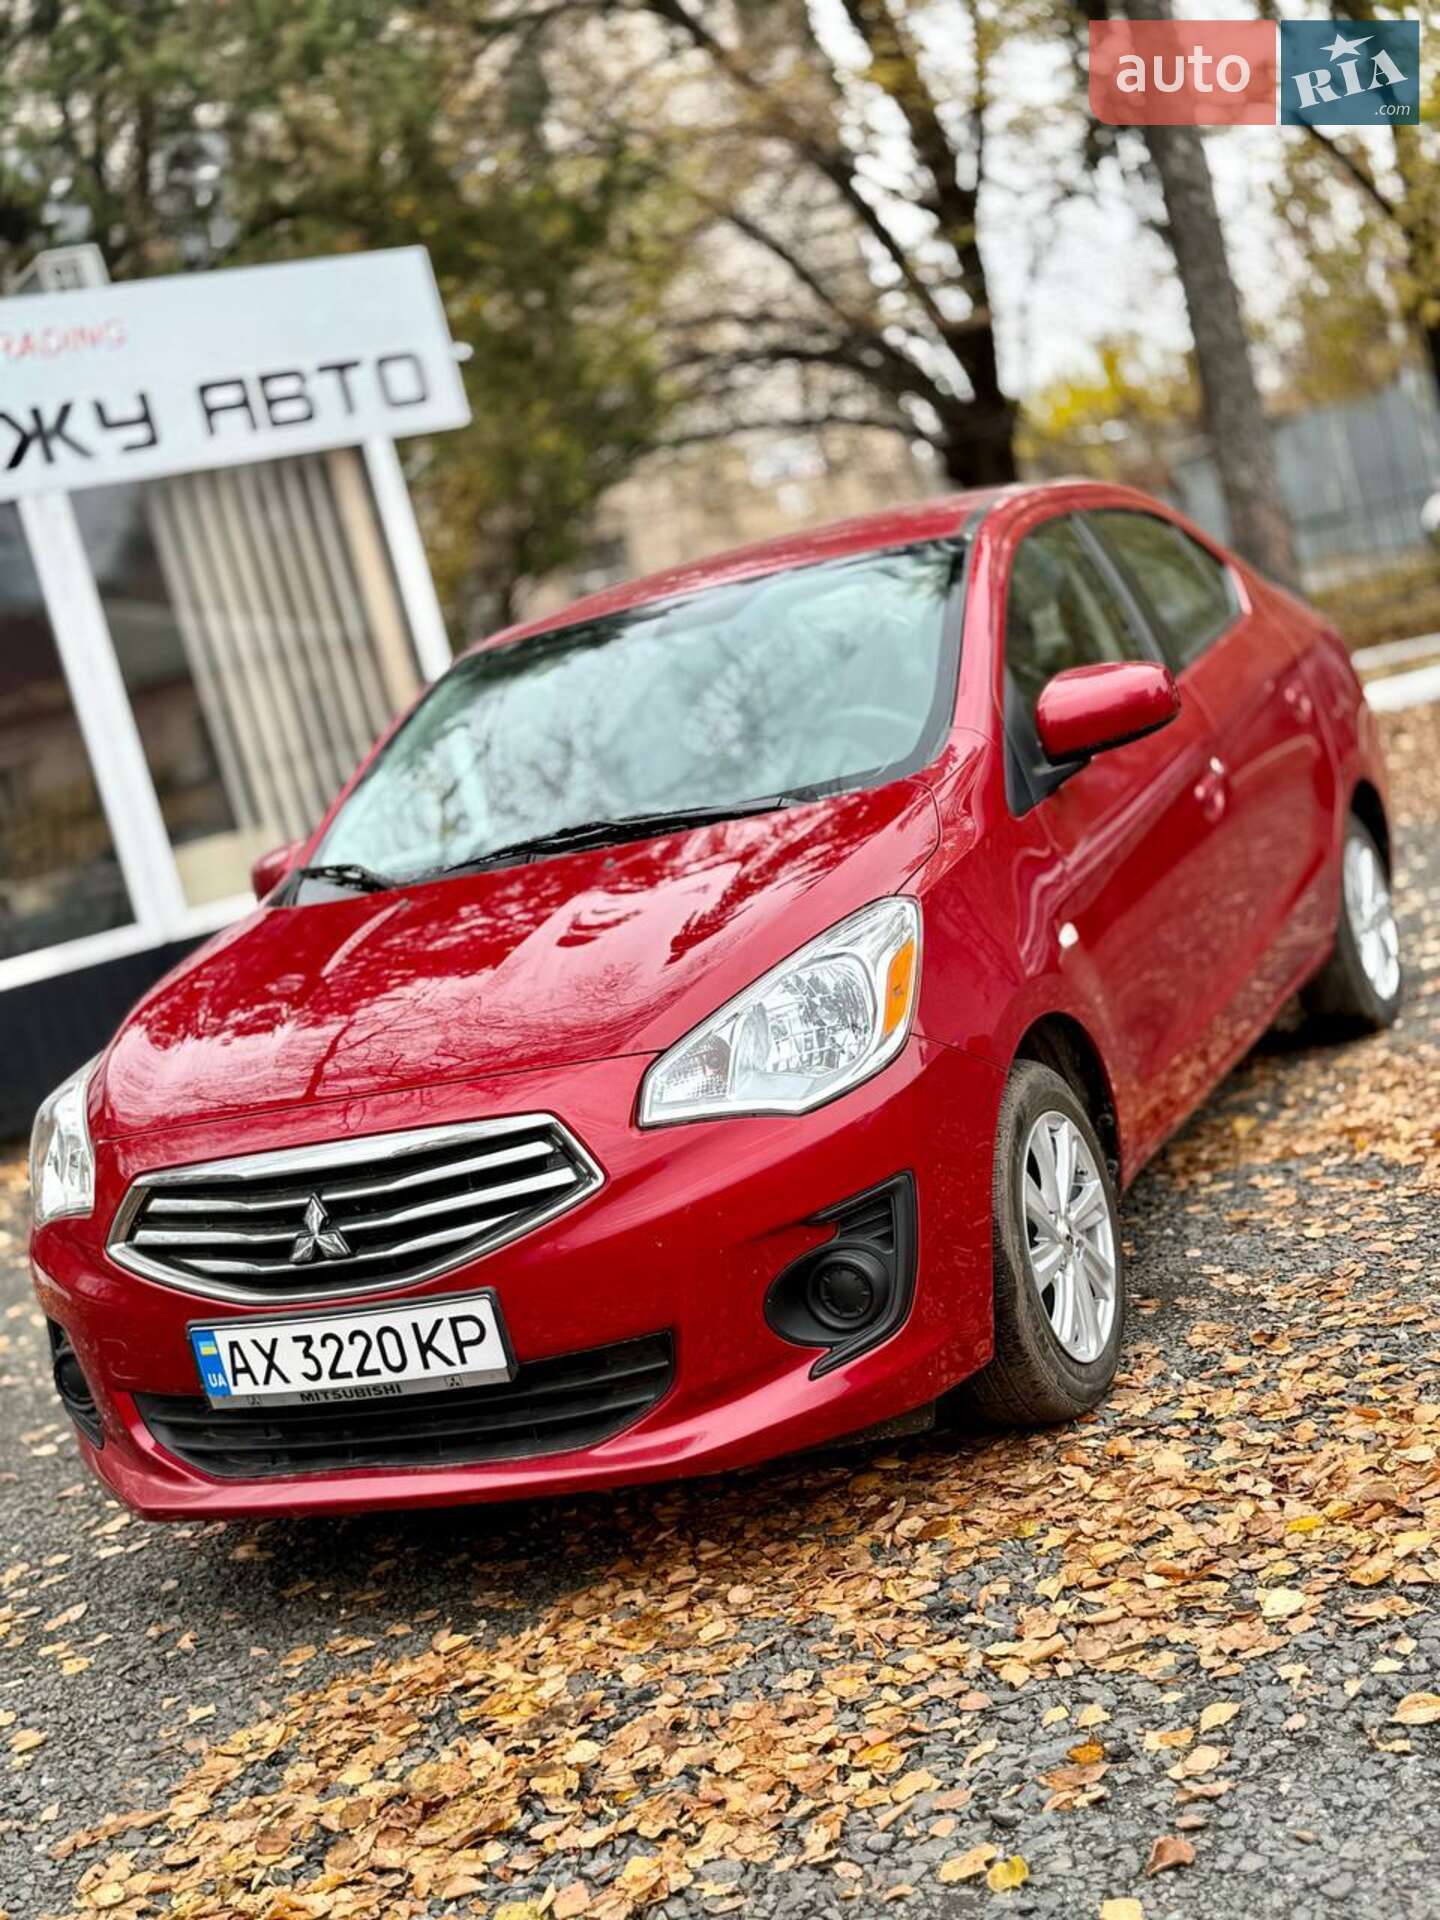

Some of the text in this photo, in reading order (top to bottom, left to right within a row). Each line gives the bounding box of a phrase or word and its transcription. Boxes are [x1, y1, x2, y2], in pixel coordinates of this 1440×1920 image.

[198, 353, 428, 436] АВТО
[228, 1314, 486, 1387] AX 3220 KP
[208, 1373, 227, 1388] UA
[299, 1383, 403, 1402] MITSUBISHI
